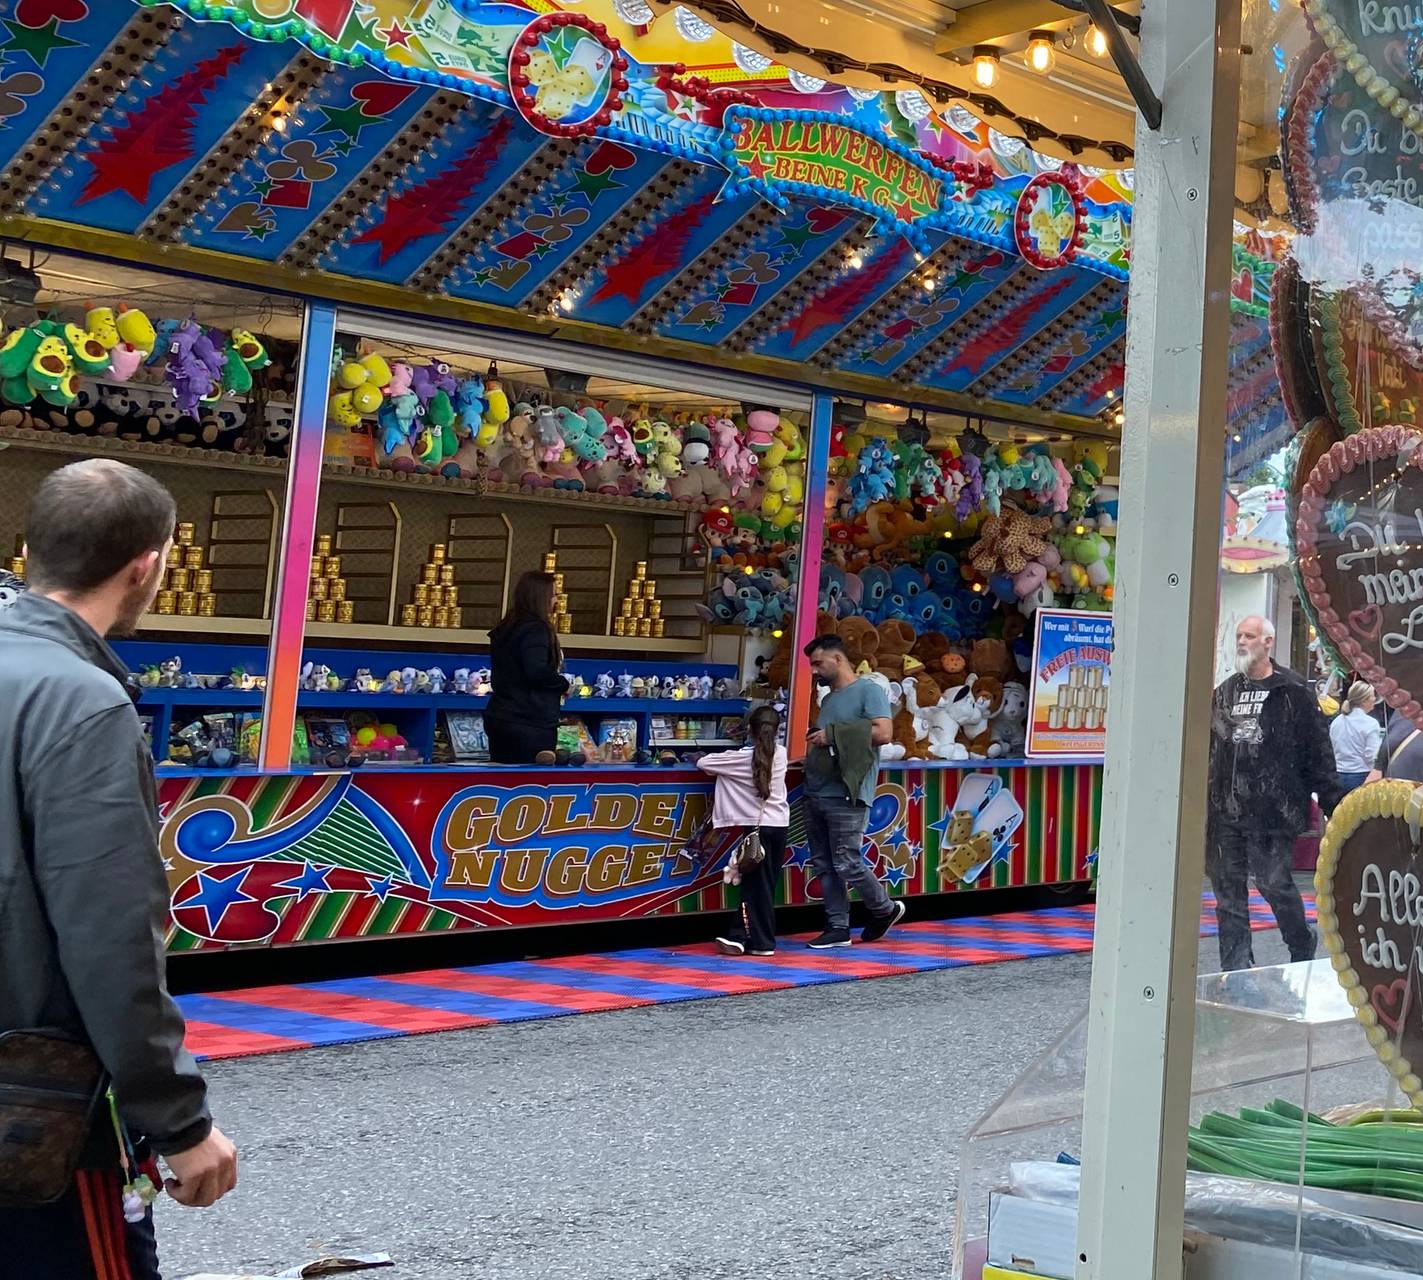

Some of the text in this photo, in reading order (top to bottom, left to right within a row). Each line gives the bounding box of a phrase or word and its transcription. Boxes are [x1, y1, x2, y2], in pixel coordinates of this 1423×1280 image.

[1340, 109, 1388, 156] Du
[732, 116, 942, 211] BALLWERFEN
[773, 156, 890, 207] BEINE K G
[1336, 521, 1408, 571] Du
[1044, 621, 1057, 631] Wer
[1057, 623, 1070, 632] mit
[1039, 647, 1076, 684] FREIE
[1357, 924, 1407, 972] ich
